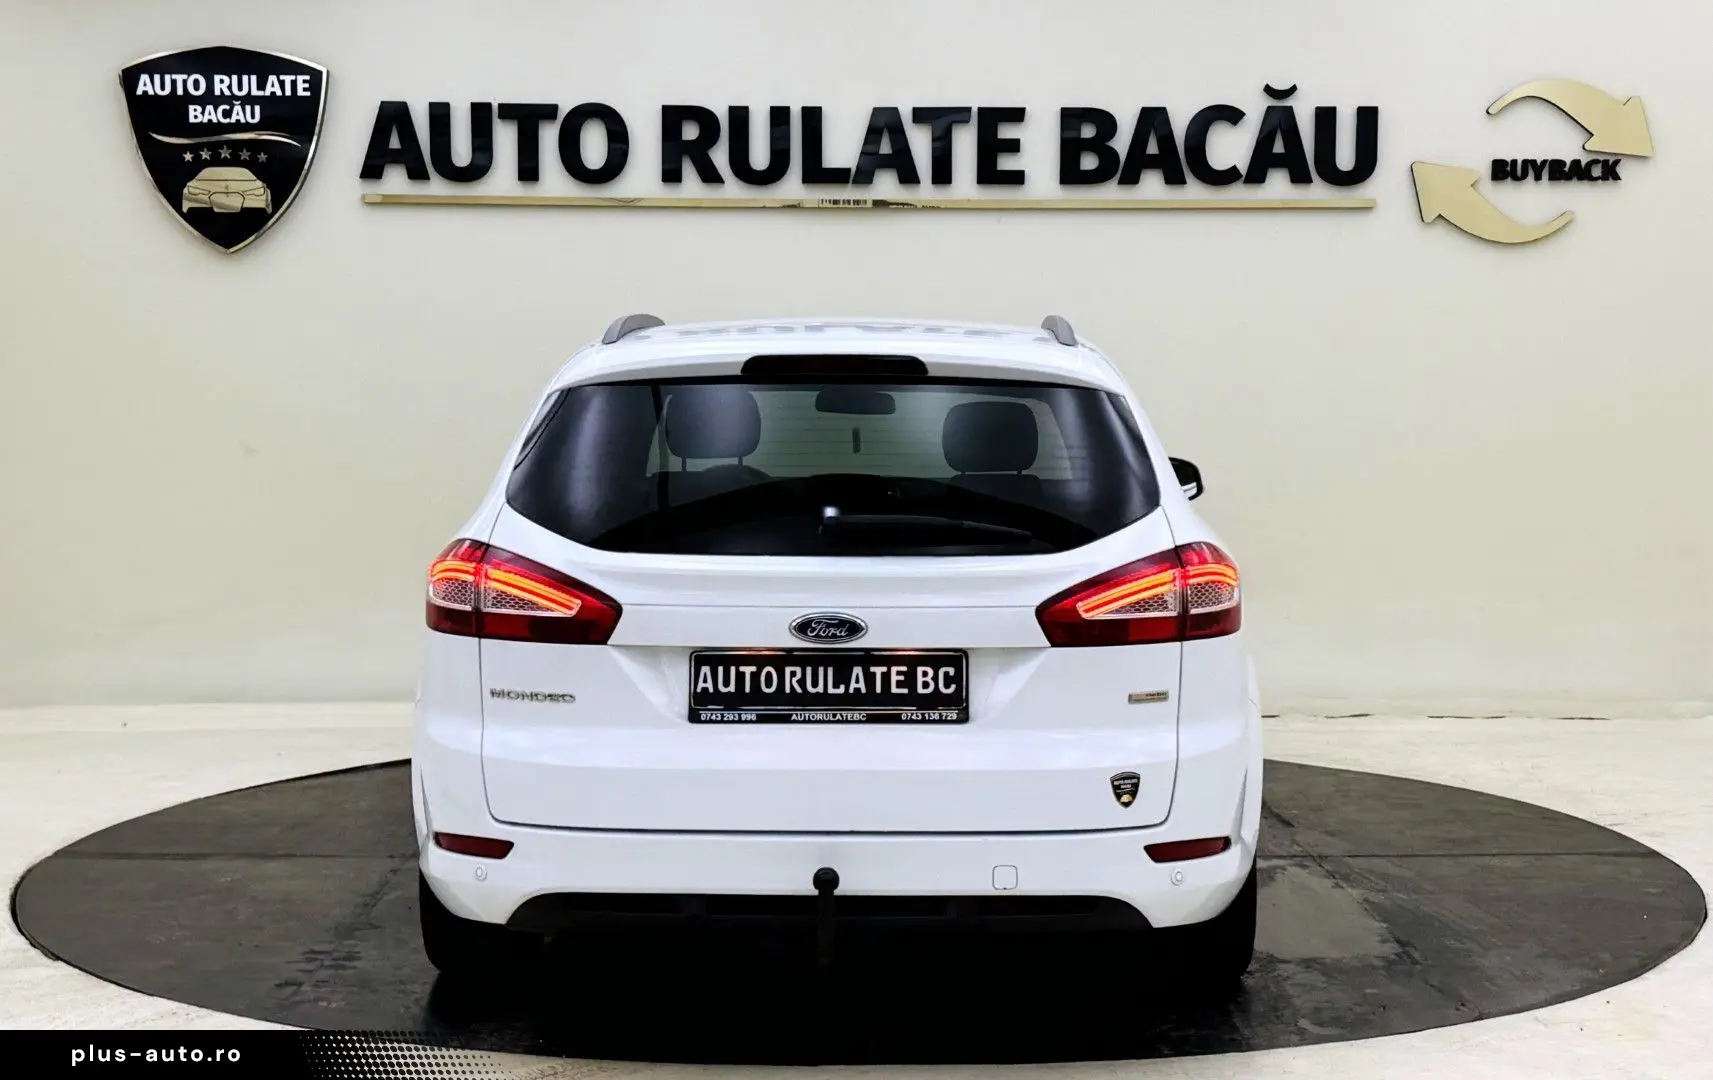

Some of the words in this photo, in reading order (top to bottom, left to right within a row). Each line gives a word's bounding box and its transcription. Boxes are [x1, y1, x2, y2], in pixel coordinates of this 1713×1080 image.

[136, 73, 206, 96] AUTO
[214, 74, 311, 96] RULATE
[188, 101, 261, 124] BACĂU
[359, 100, 630, 185] AUTO
[661, 104, 1026, 185] RULATE
[1059, 83, 1379, 186] BACĂU
[1491, 158, 1622, 181] BUYBACK
[807, 619, 850, 636] Ford
[696, 666, 778, 694] AUTO
[784, 666, 909, 694] RULATE
[916, 666, 957, 694] BC
[700, 713, 721, 721] 0743
[791, 712, 867, 721] AUTORULATEBC
[901, 712, 922, 720] 0743
